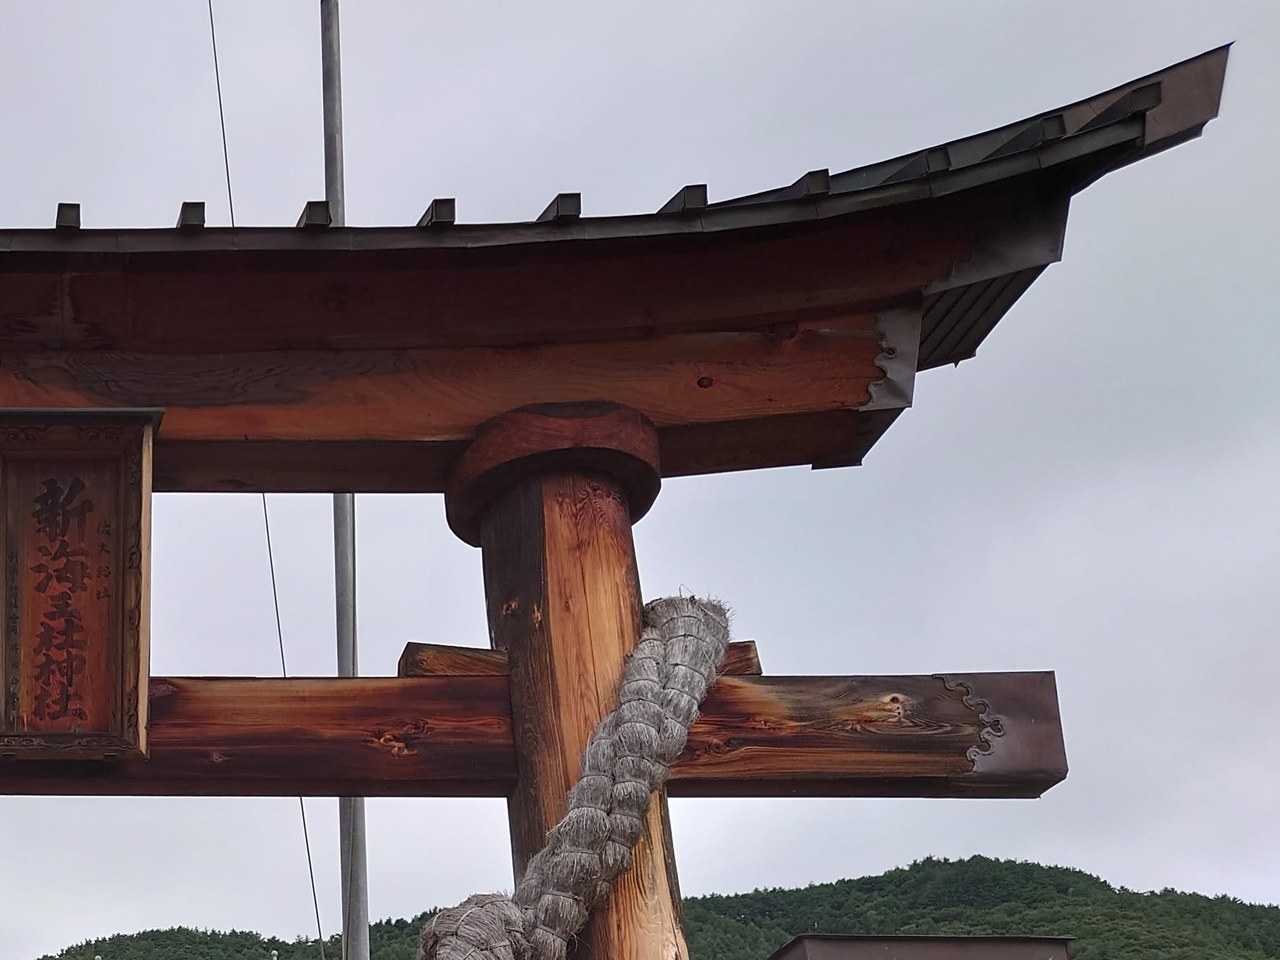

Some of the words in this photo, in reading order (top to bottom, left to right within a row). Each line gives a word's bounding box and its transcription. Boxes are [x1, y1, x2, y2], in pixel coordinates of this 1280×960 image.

[29, 477, 95, 722] 新海三社神社
